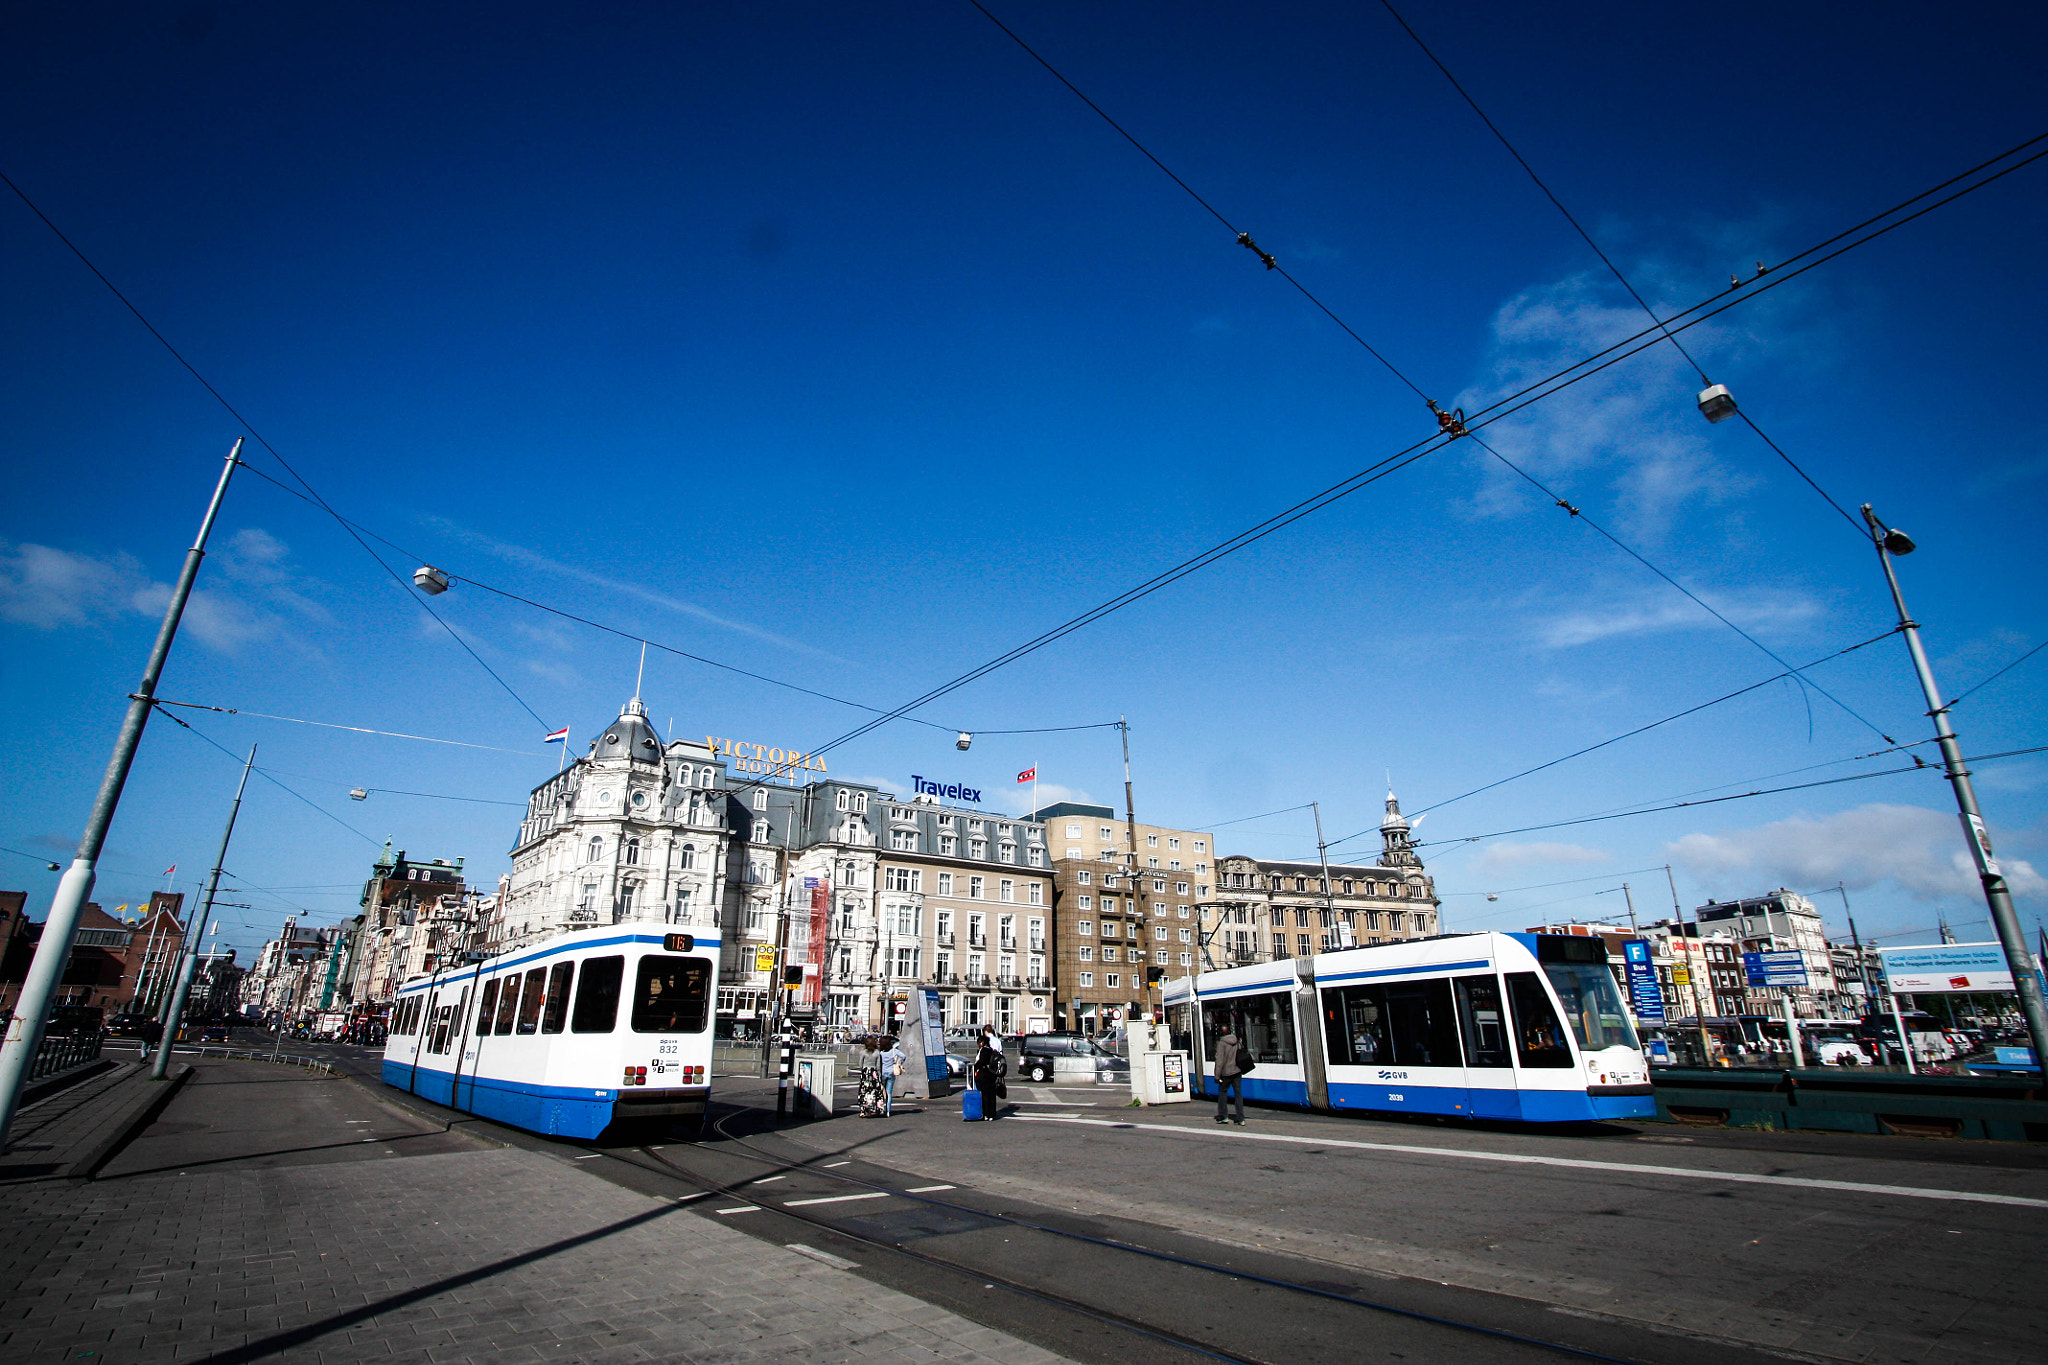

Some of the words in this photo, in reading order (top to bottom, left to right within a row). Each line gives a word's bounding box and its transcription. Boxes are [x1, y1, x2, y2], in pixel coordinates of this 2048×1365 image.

[705, 735, 828, 773] VICTORIA
[735, 759, 798, 780] HOTEL
[911, 774, 982, 803] Travelex
[672, 936, 686, 950] 16
[1631, 947, 1641, 960] F
[659, 1045, 678, 1054] 832
[1392, 1071, 1408, 1079] GVB
[1388, 1093, 1404, 1102] 2039
